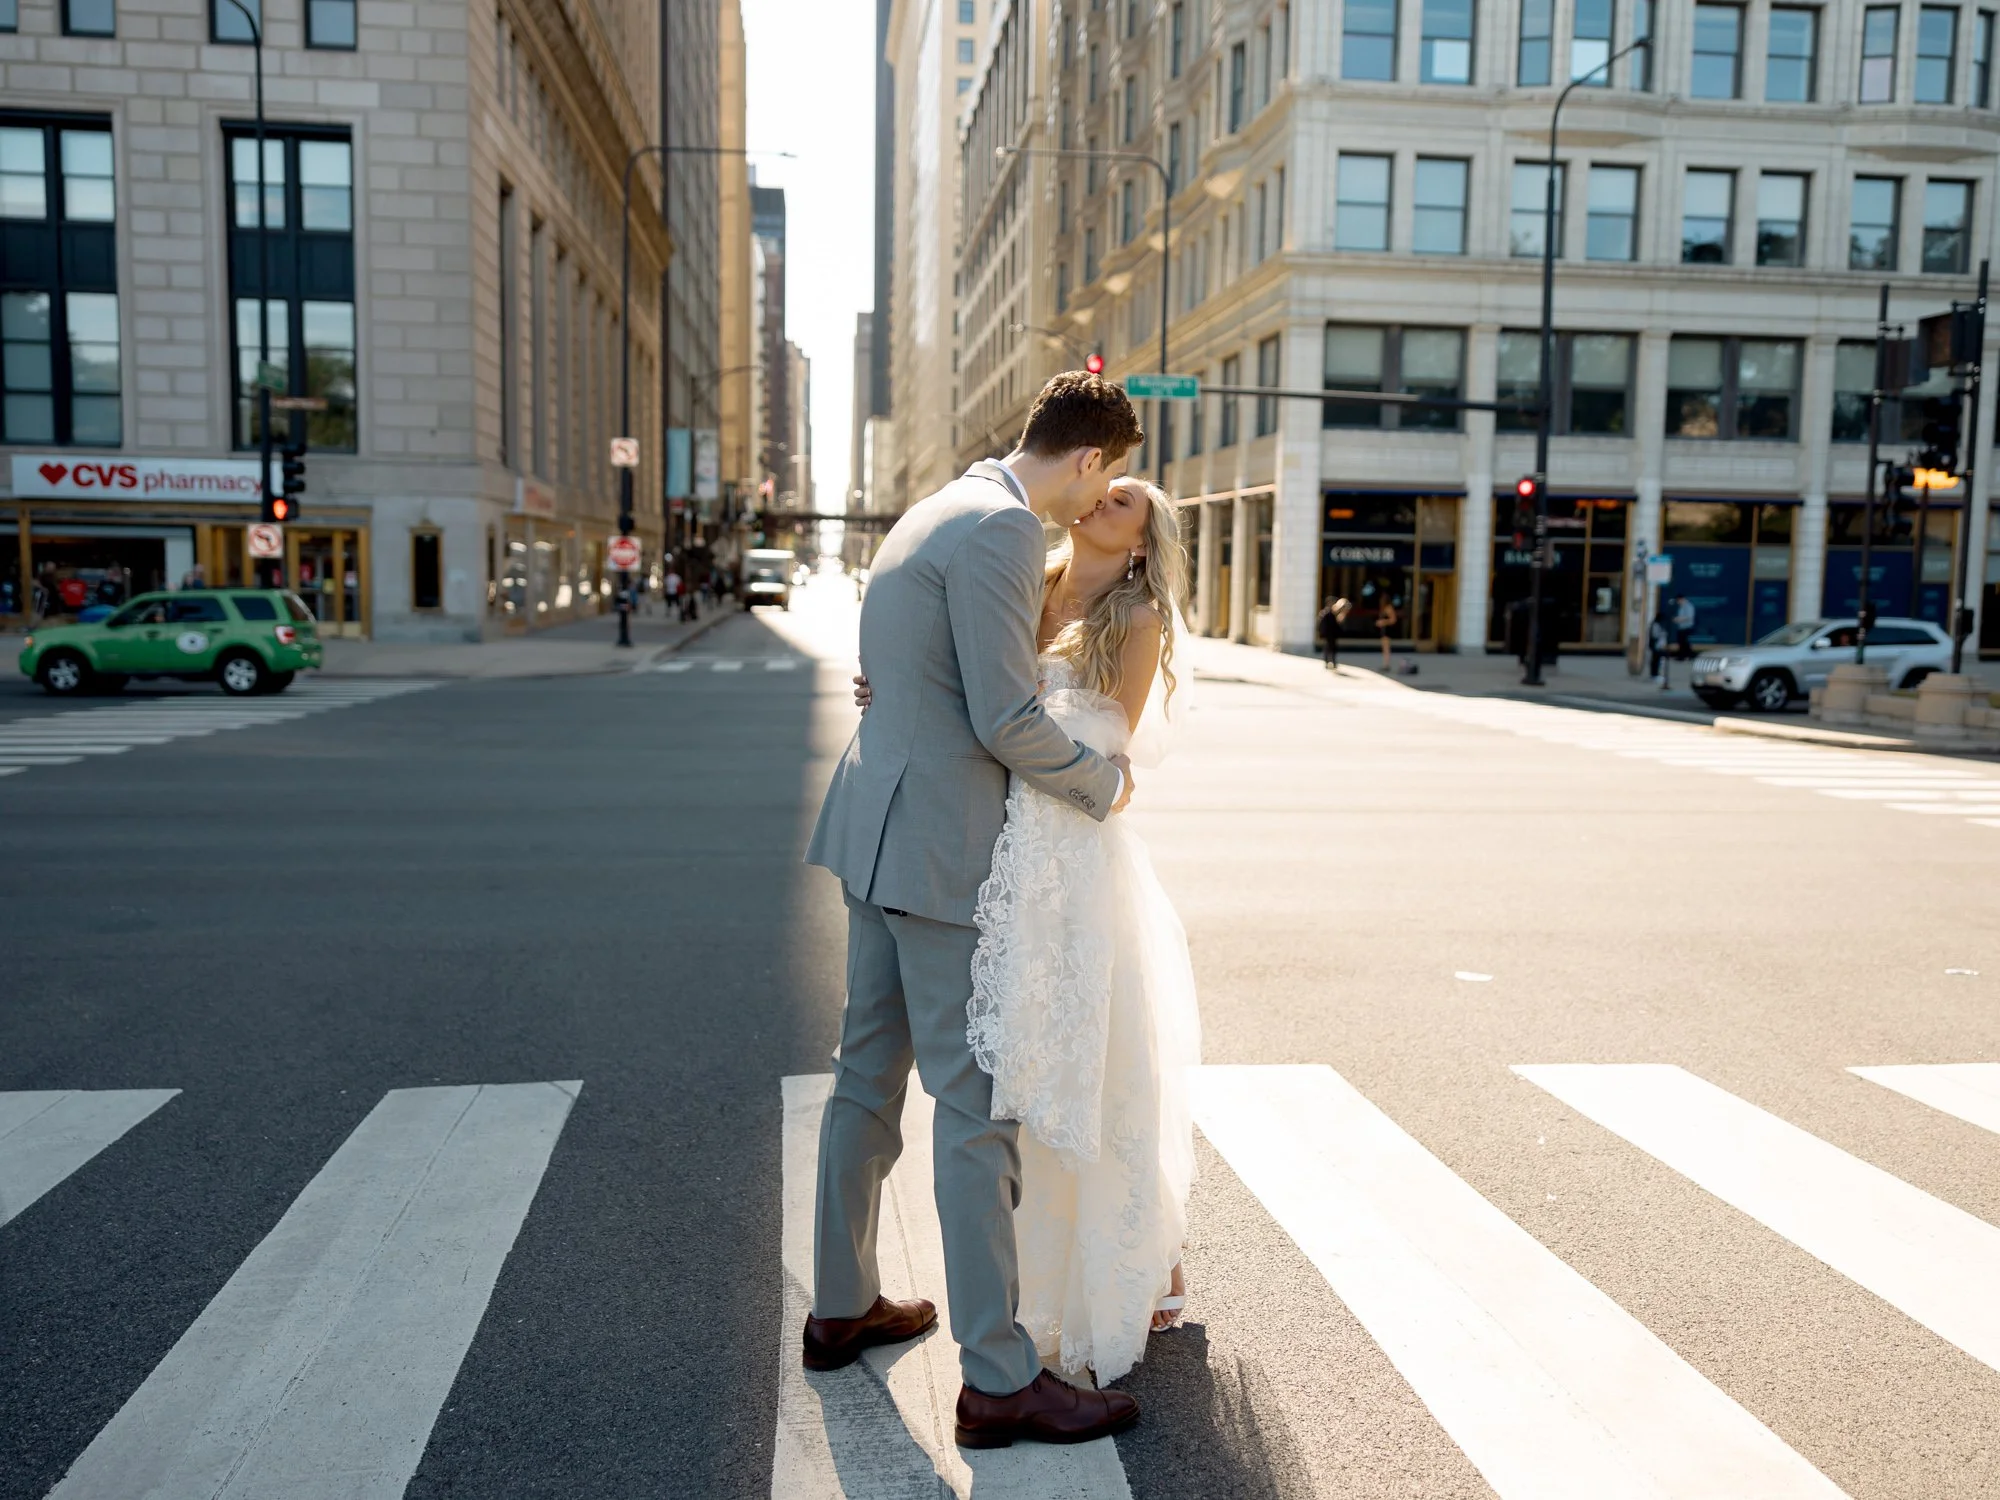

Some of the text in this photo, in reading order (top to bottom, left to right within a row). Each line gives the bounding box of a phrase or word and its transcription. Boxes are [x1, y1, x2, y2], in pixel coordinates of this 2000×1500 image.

[72, 463, 262, 494] CVS pharmacy
[1330, 547, 1394, 561] CORNER
